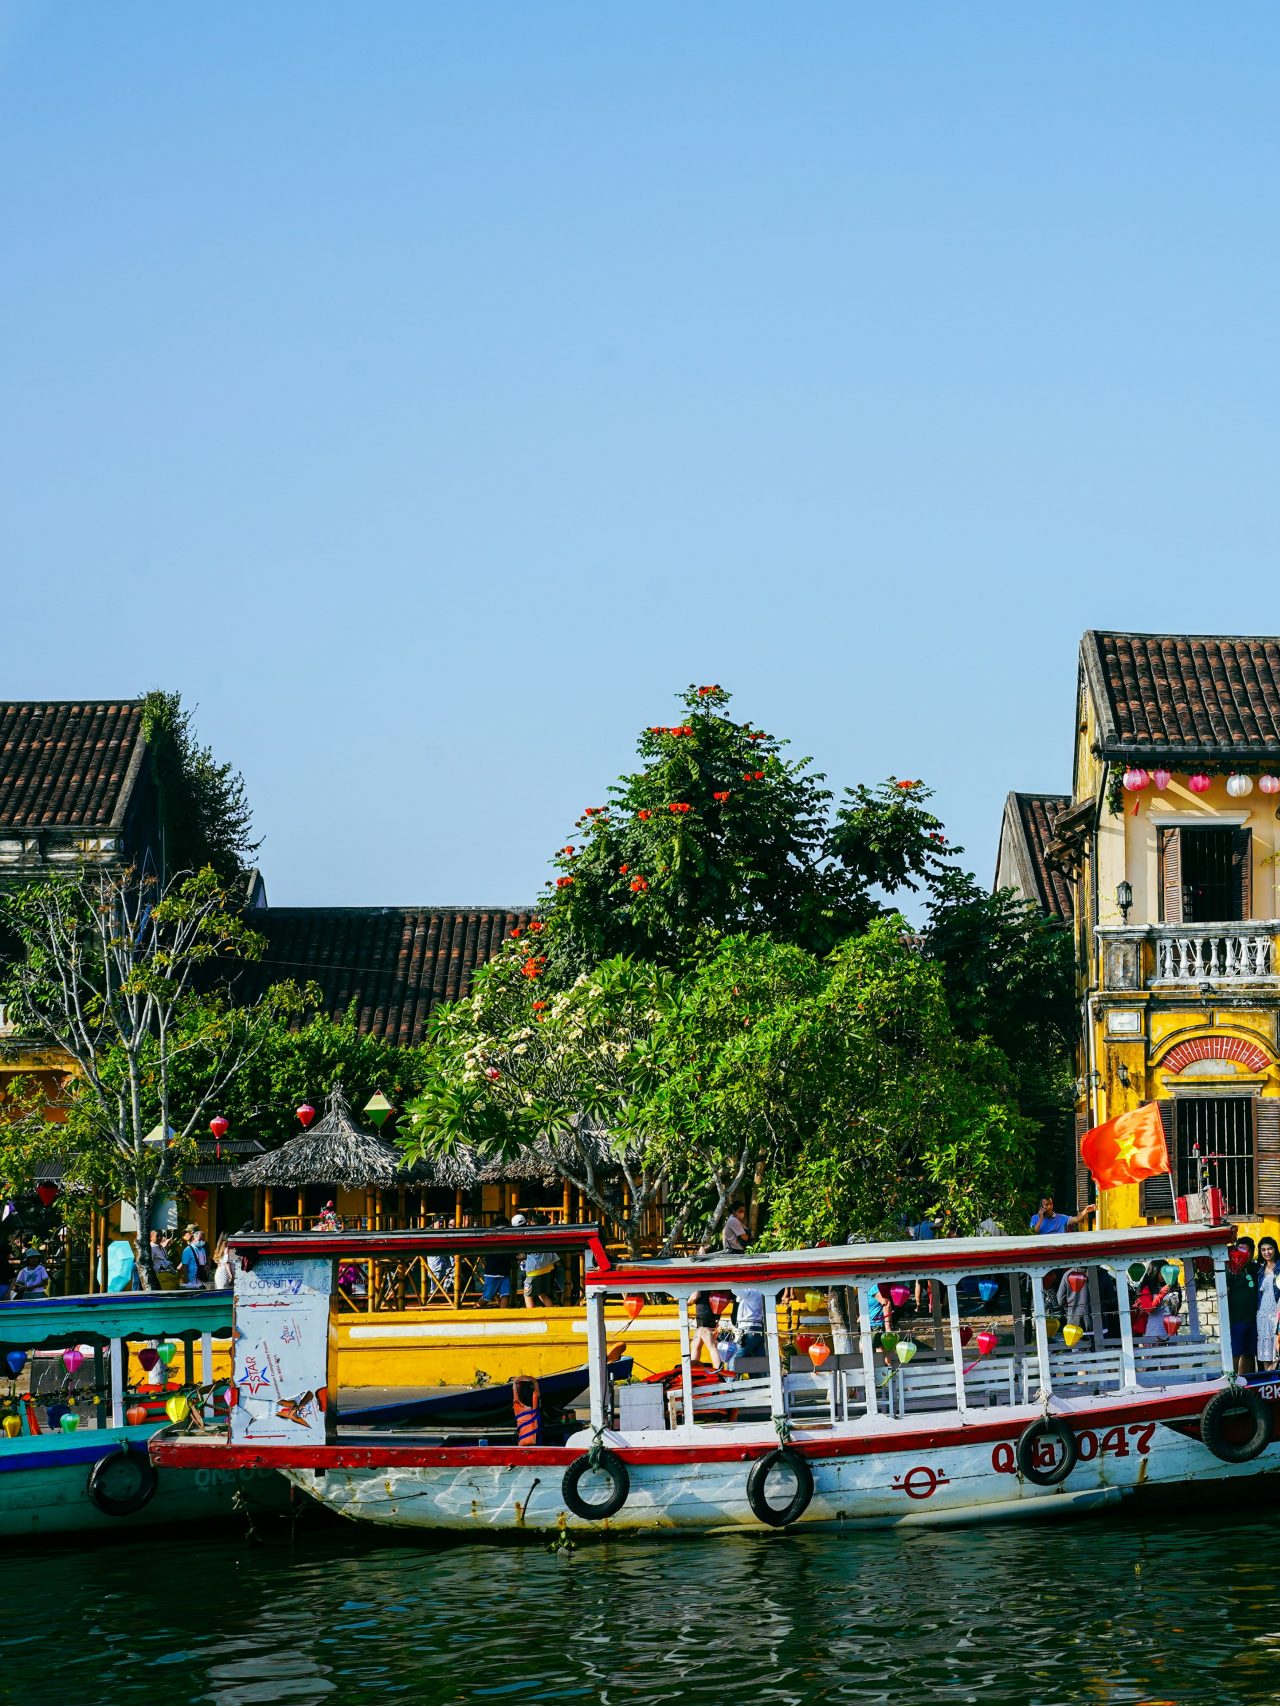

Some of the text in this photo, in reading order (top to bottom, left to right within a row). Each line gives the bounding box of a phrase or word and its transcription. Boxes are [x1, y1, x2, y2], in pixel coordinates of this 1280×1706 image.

[246, 1356, 260, 1382] STAR
[992, 1422, 1156, 1474] Qa047
[938, 1468, 946, 1477] R
